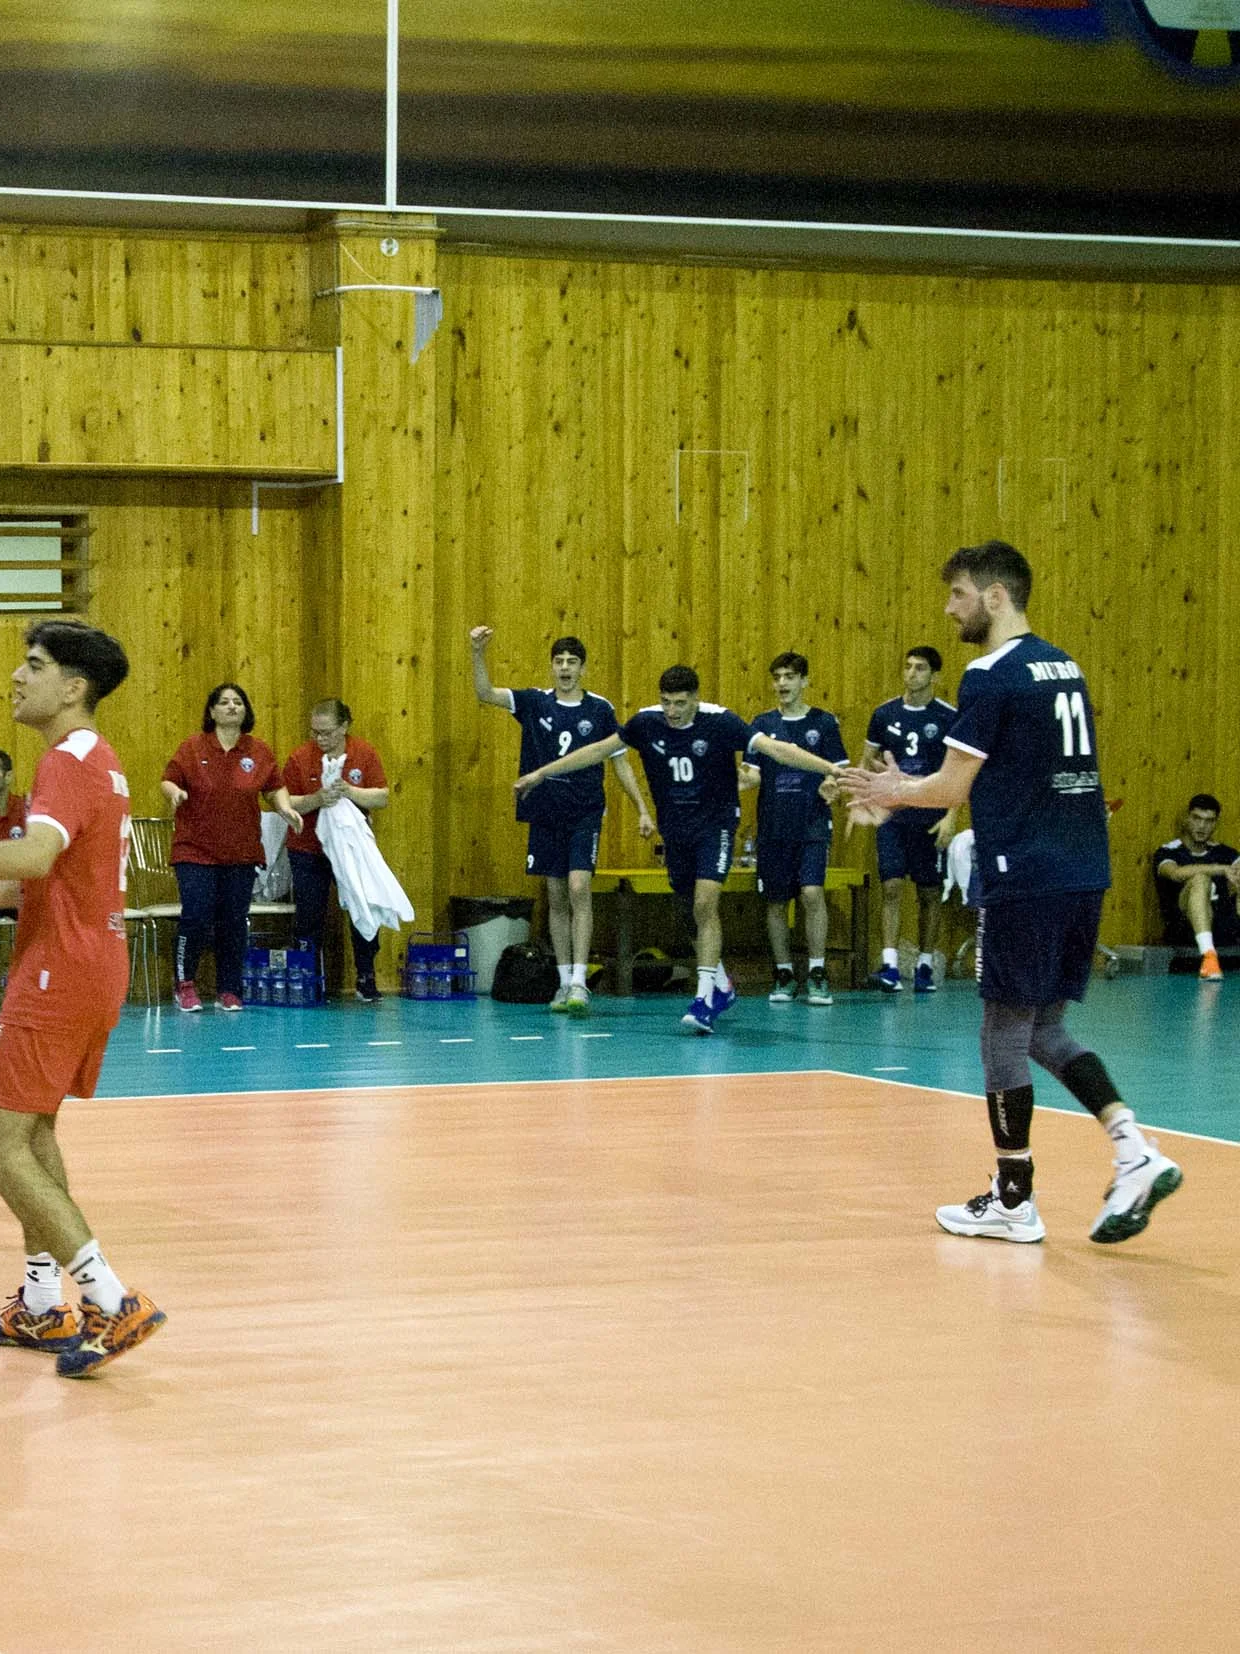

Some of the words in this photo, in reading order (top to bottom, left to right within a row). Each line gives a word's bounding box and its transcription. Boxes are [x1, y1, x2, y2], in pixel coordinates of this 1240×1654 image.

[1026, 661, 1085, 682] MURO
[1055, 692, 1092, 757] 11
[558, 731, 572, 757] 9
[905, 732, 919, 756] 3
[668, 757, 694, 783] 10
[527, 854, 535, 869] 9
